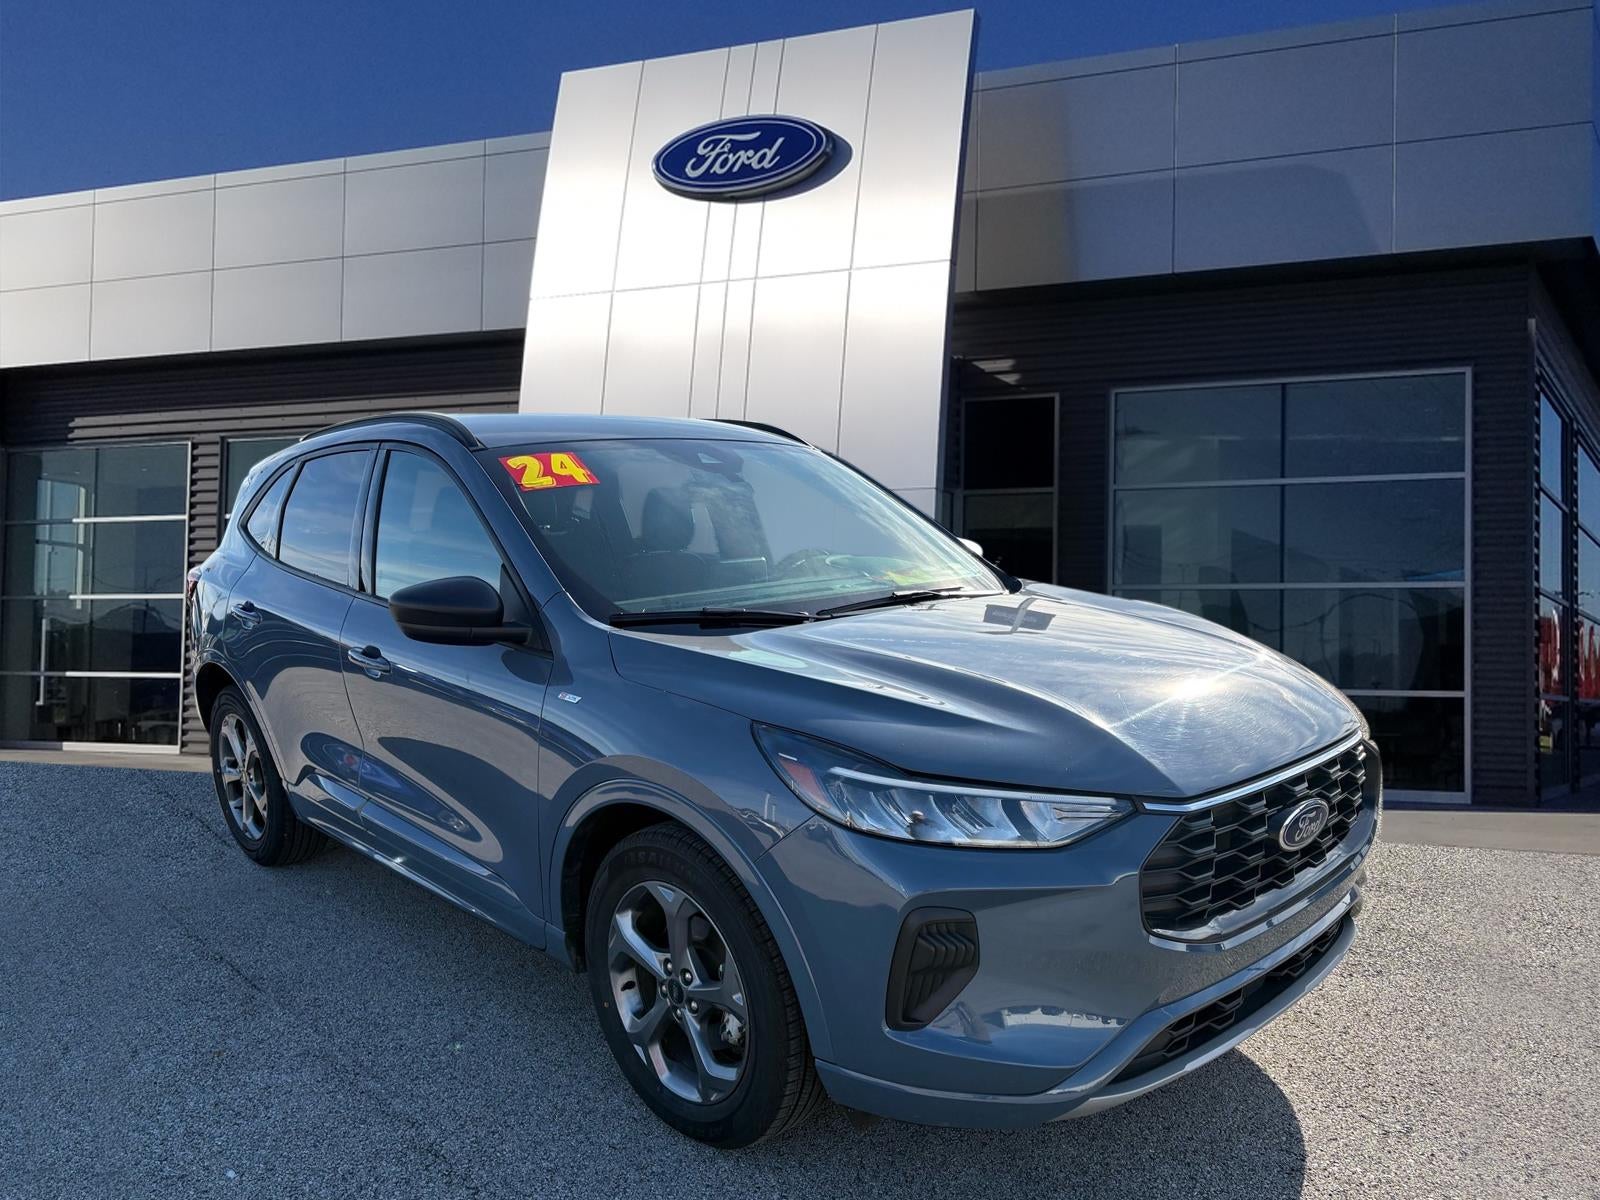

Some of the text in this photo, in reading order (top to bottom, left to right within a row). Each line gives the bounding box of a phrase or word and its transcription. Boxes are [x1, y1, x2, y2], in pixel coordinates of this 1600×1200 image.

[685, 131, 784, 178] Ford
[507, 453, 592, 487] 24
[1295, 810, 1322, 841] Ford
